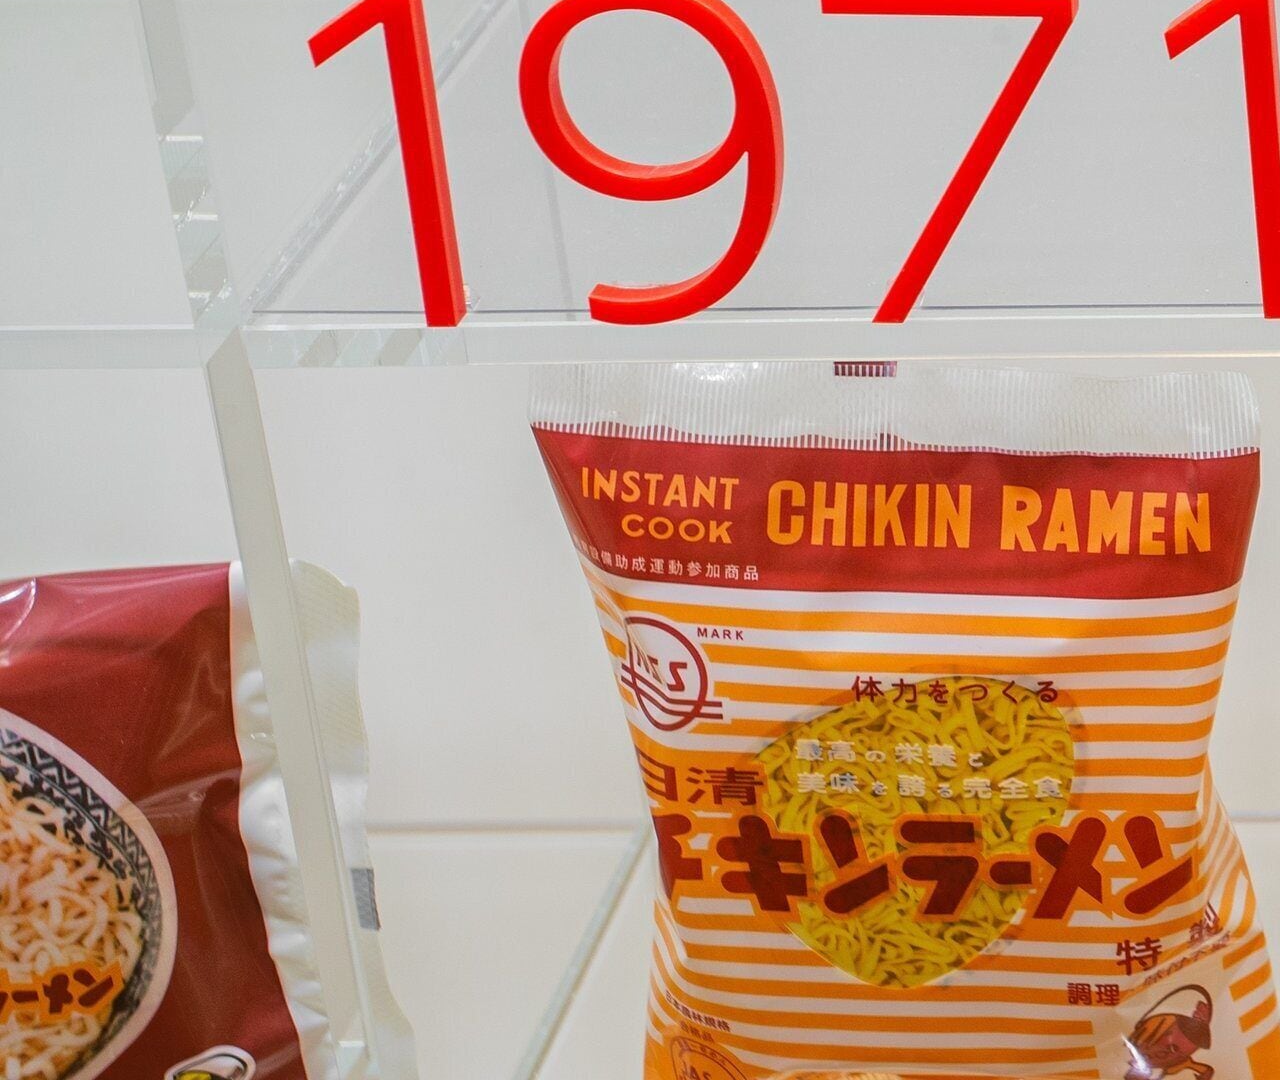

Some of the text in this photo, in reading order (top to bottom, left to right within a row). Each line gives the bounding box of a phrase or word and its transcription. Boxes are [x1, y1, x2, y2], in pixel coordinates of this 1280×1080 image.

[580, 466, 740, 512] INSTANT
[620, 513, 734, 545] COOK
[767, 479, 1213, 557] CHIKIN RAMEN
[697, 627, 745, 641] MARK
[850, 674, 1060, 706] 体力をつくる
[794, 740, 984, 769] 最高の栄養と
[641, 749, 764, 806] 日清
[795, 771, 1065, 800] 美味を誇る完全食
[653, 813, 1194, 919] チキンラーメン
[1066, 982, 1121, 1007] 調理
